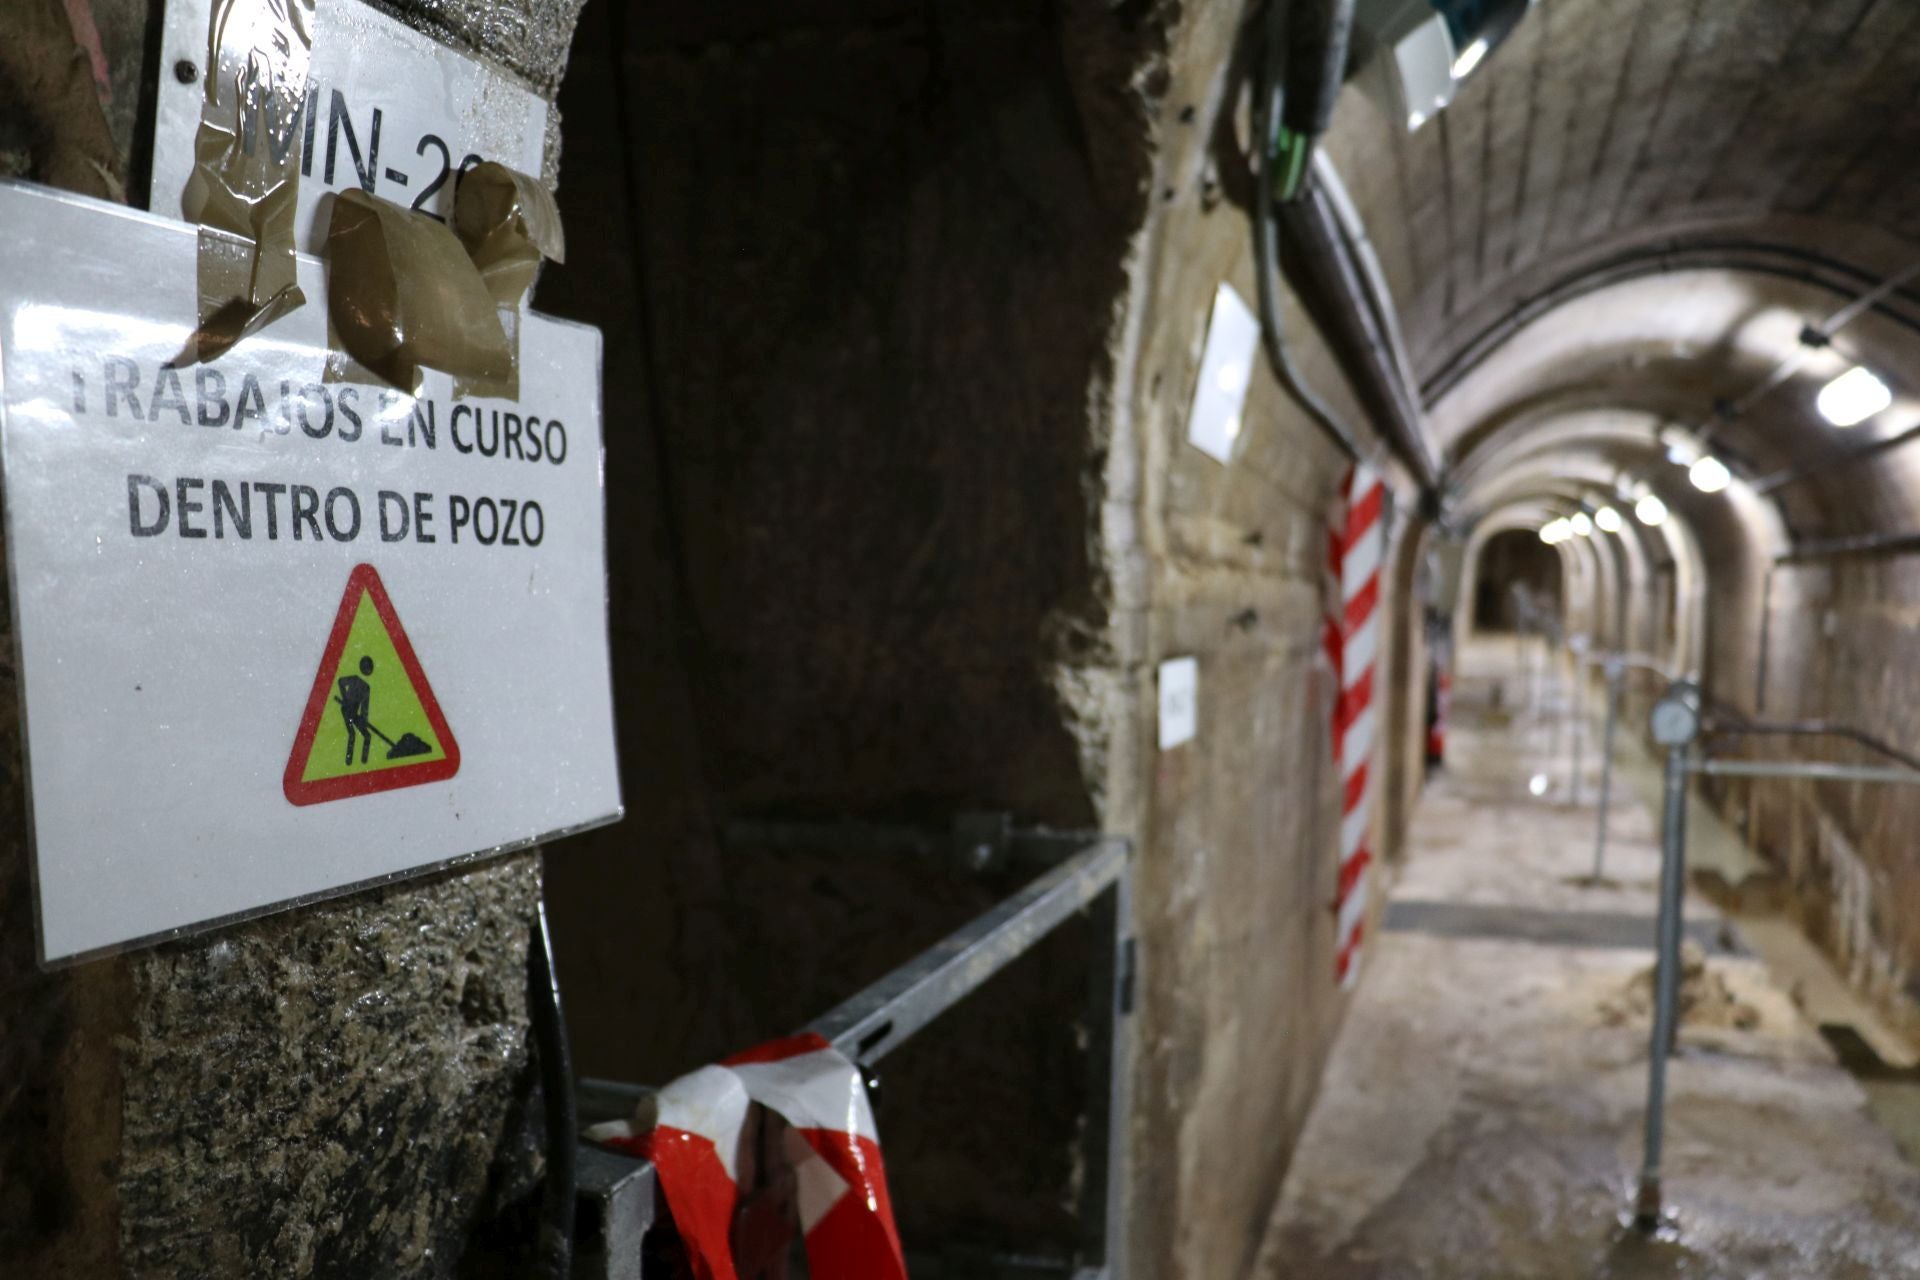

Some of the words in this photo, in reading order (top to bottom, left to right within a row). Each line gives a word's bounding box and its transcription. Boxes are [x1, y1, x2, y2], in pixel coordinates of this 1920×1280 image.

[449, 403, 568, 466] CURSO
[127, 473, 362, 543] DENTRO
[377, 489, 437, 544] DE
[449, 494, 545, 547] POZO
